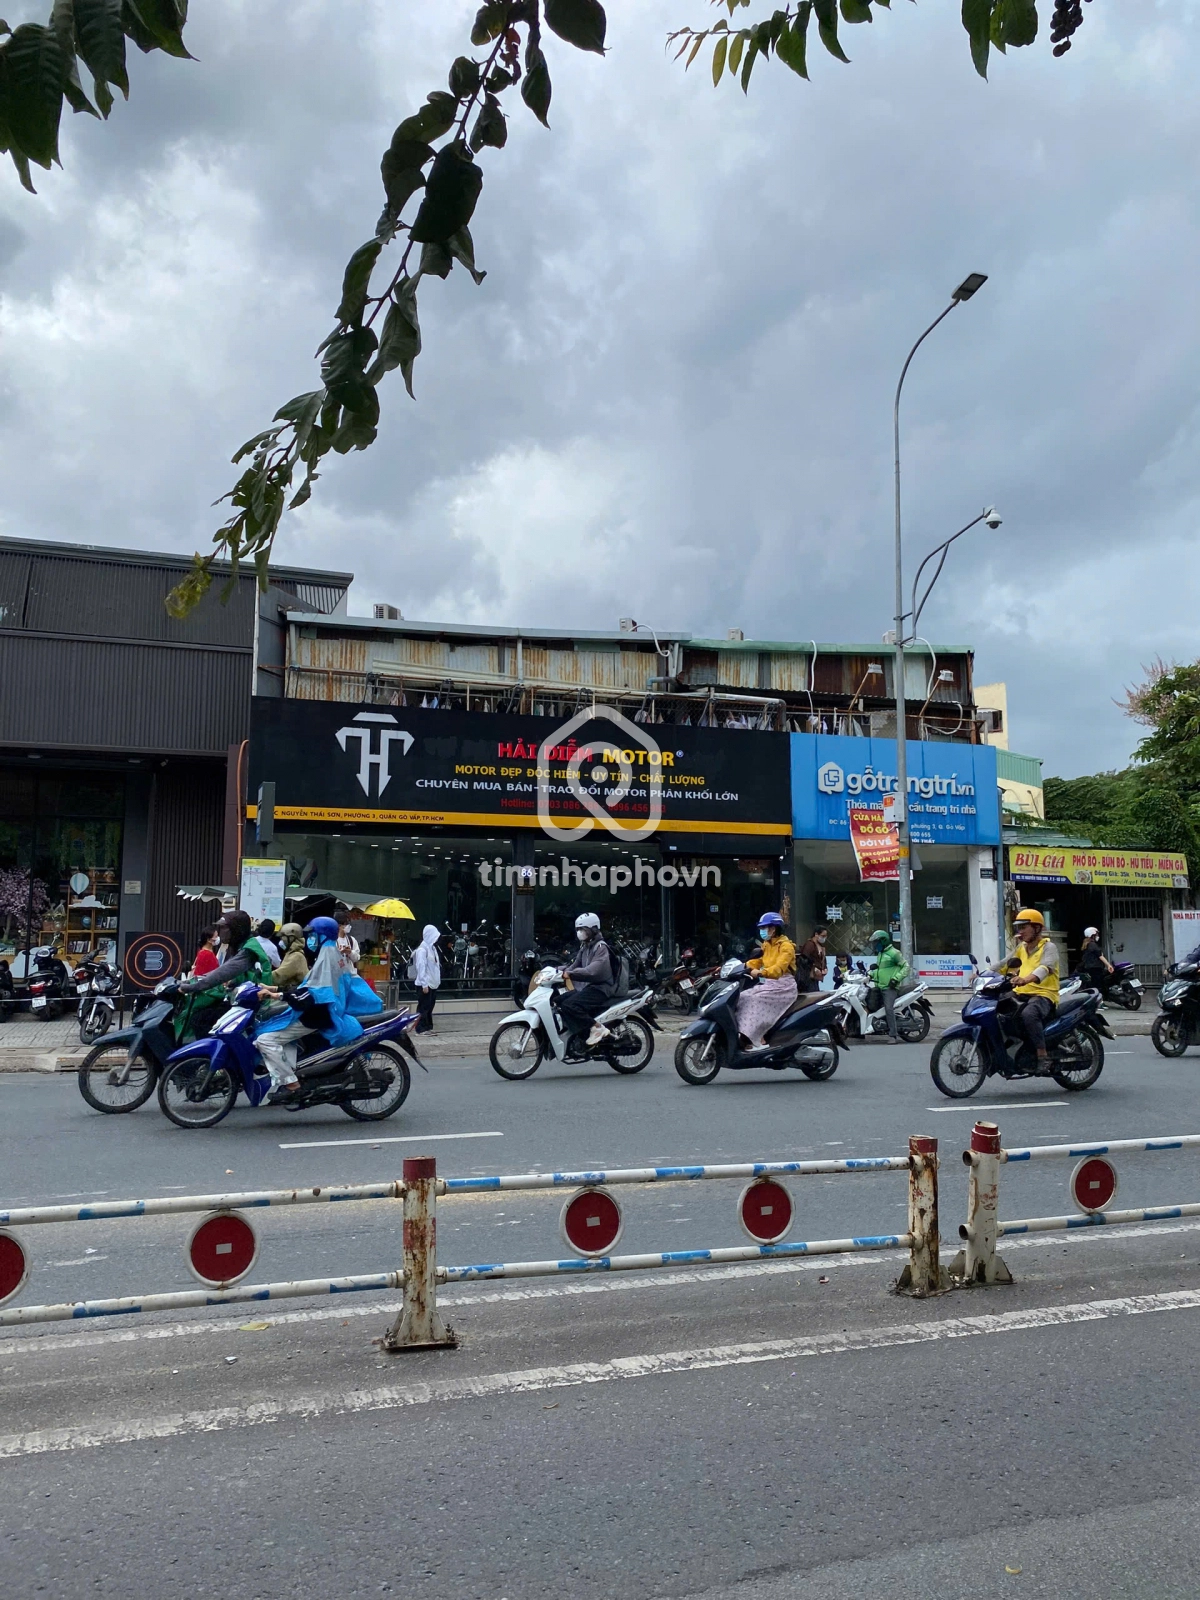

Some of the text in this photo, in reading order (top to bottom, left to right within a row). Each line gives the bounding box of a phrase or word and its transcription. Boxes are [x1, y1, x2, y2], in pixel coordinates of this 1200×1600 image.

[498, 738, 537, 759] HẢI
[455, 765, 705, 787] MOTOR ĐẸP ĐỘC HIẾM UY TÍN CHẤT LƯỢNG
[415, 778, 468, 790] CHUYÊN
[473, 782, 502, 791] MUA
[578, 783, 600, 795] ĐỔI
[604, 788, 647, 798] MOTOR
[650, 789, 682, 799] PHÂN
[685, 789, 712, 800] KHỐI
[715, 791, 739, 801] LỚN
[281, 808, 309, 818] NGUYỄN
[869, 799, 884, 810] mã
[925, 804, 948, 815] trang
[950, 804, 959, 813] trí
[961, 804, 977, 814] nhà
[853, 812, 870, 822] CỬA
[871, 813, 884, 822] HÀ
[859, 822, 890, 834] ĐỒ GỖ
[1014, 850, 1040, 867] BÙI
[1101, 853, 1115, 868] BÚN
[521, 868, 532, 877] 86
